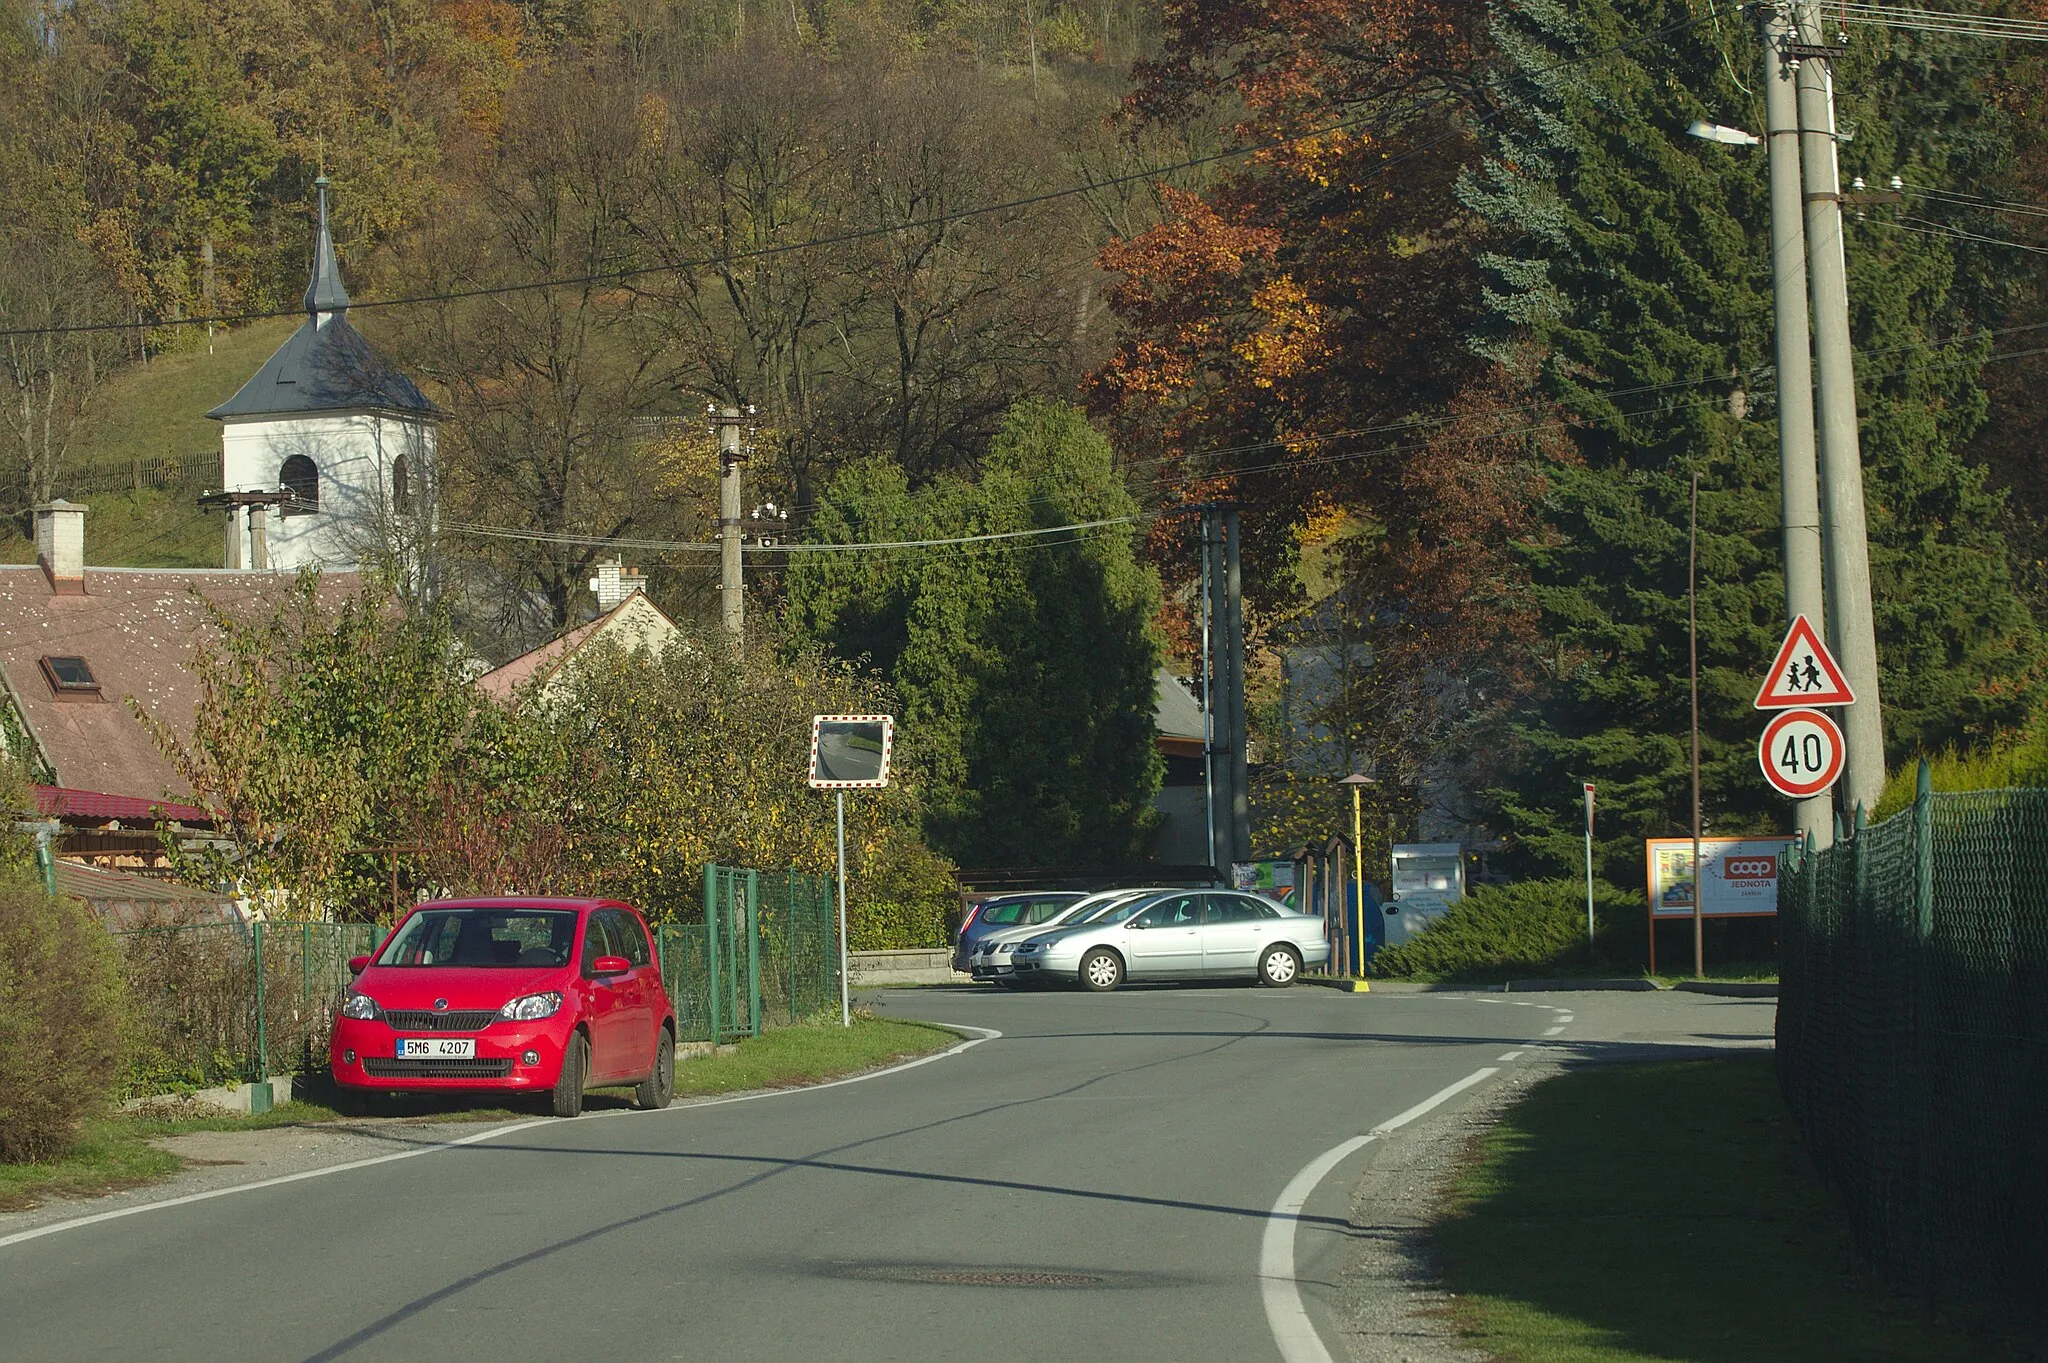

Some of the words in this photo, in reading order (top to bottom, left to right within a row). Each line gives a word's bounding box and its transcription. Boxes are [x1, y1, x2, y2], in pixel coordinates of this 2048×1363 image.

[1781, 733, 1822, 774] 40
[1731, 880, 1771, 888] JEDNOTA
[407, 1041, 430, 1055] 5M6
[439, 1041, 469, 1055] 4207
